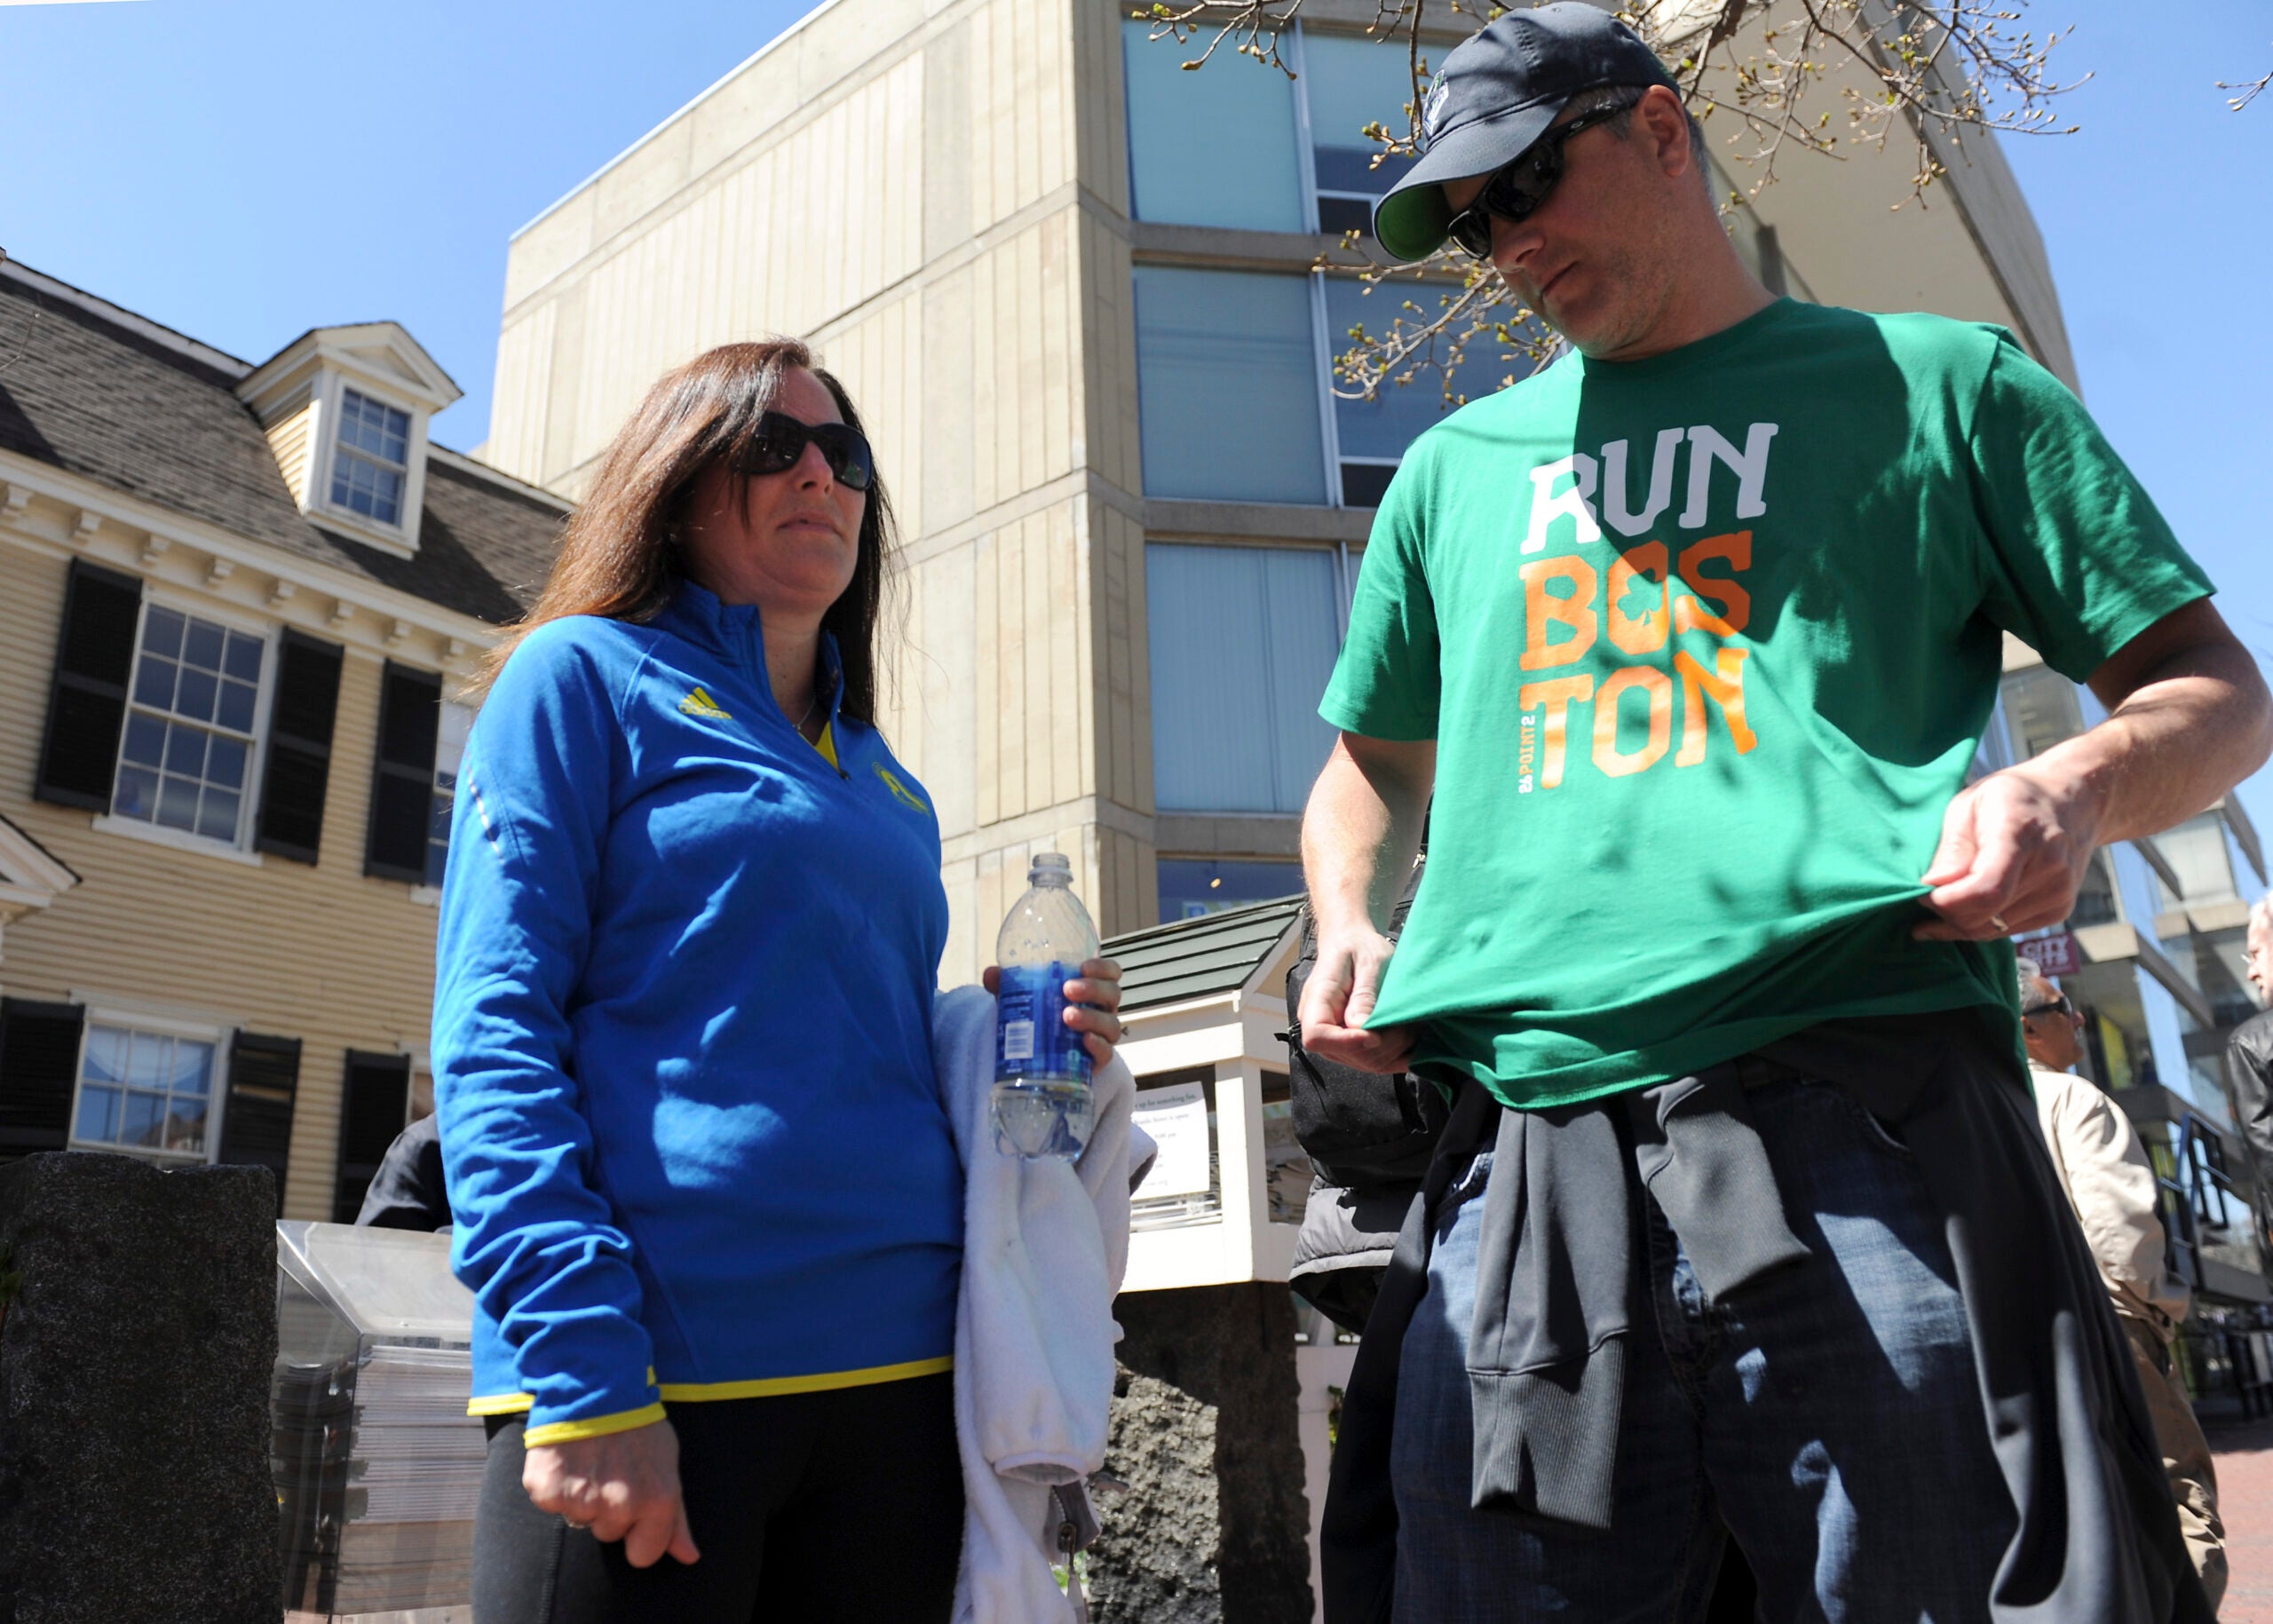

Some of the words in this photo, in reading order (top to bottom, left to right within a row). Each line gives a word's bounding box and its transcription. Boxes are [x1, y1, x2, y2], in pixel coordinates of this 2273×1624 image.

[1519, 423, 1778, 554] RUN
[1518, 530, 1752, 670] BOS
[1519, 648, 1757, 788] TON
